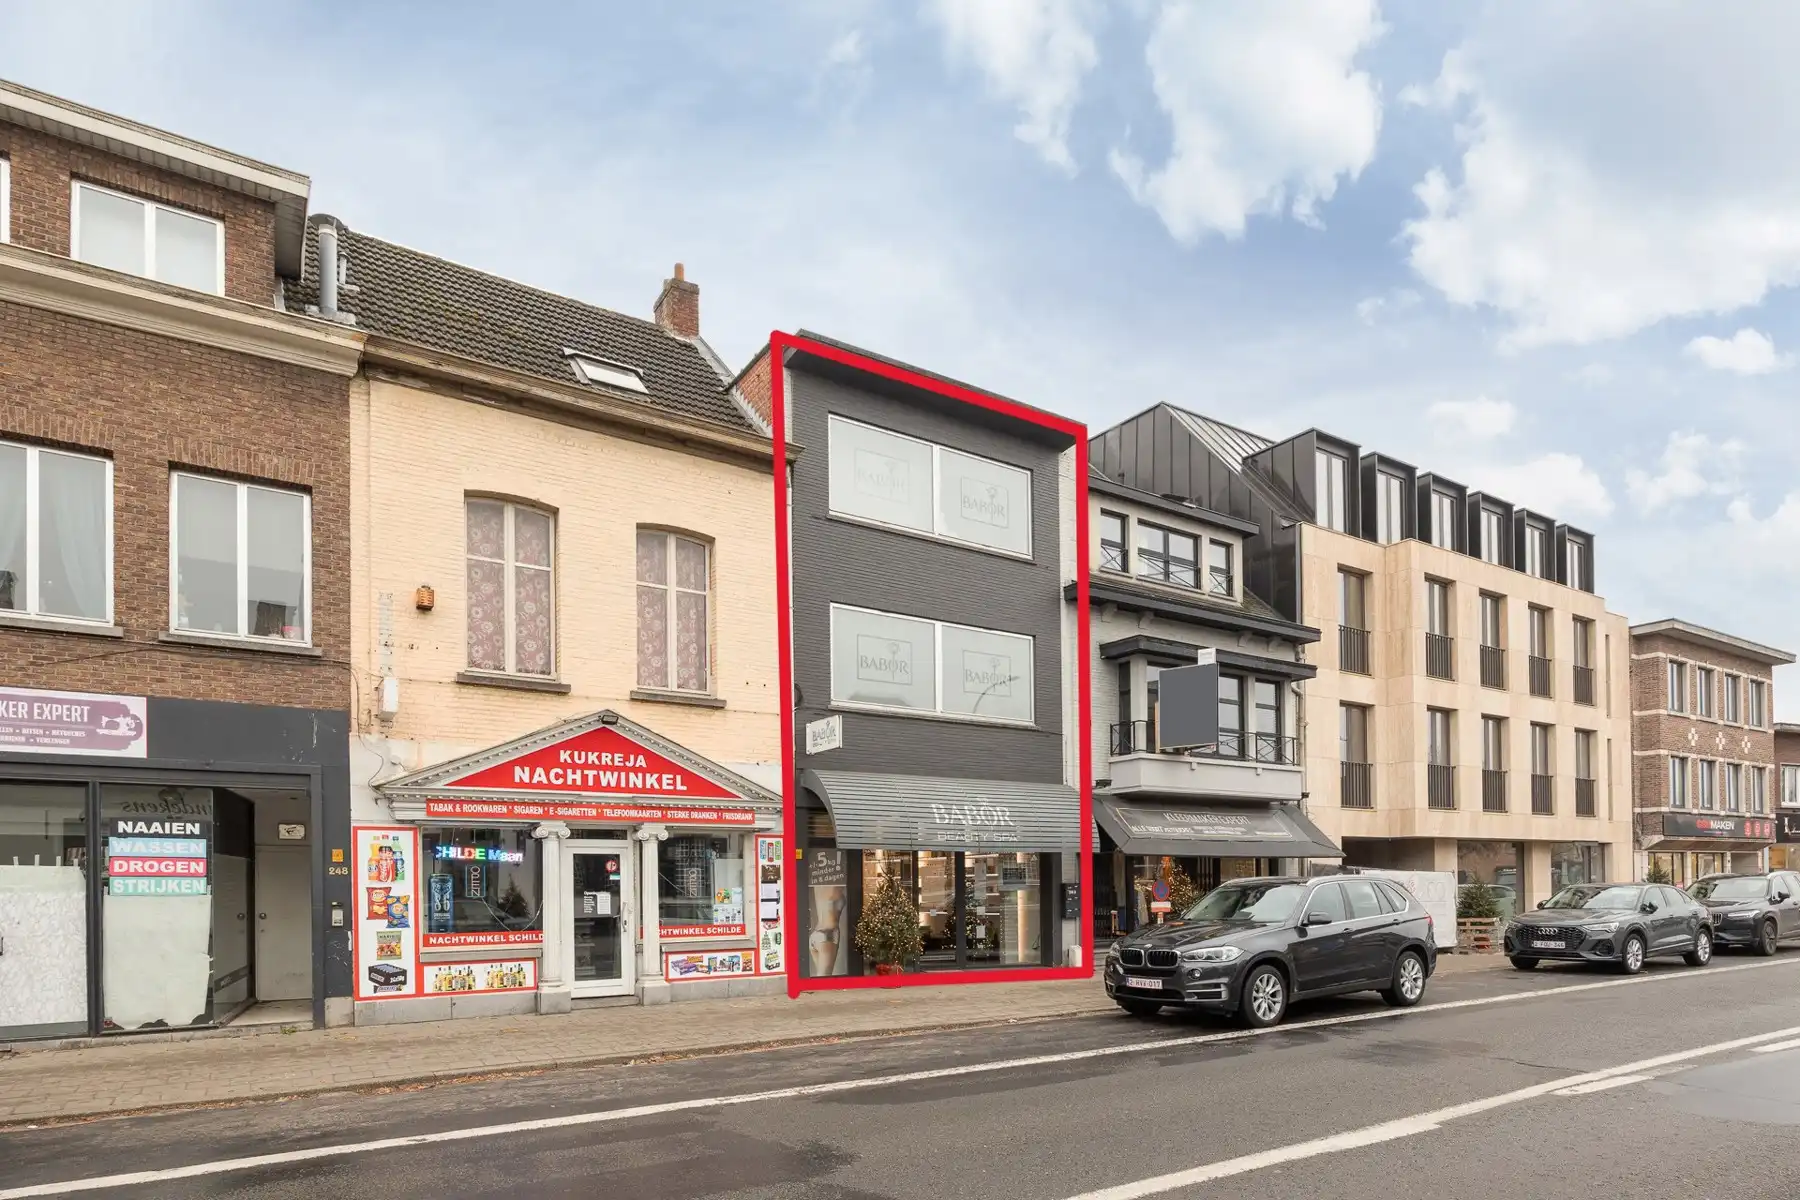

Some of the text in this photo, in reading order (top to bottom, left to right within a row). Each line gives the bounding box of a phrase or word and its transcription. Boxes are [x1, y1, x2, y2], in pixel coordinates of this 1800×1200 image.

[963, 495, 1006, 518] BABOR
[860, 655, 910, 675] BABOR
[965, 668, 1008, 687] BABOR
[34, 702, 91, 722] EXPERT
[560, 750, 647, 767] KUKREJA
[514, 766, 687, 790] NACHTWINKEL
[429, 803, 454, 812] TABAK
[455, 803, 461, 812] &
[463, 804, 507, 813] ROOKWAREN
[513, 805, 543, 815] SIGAREN
[603, 808, 661, 819] TELEFOONKAARTEN
[667, 810, 690, 819] STERKE
[691, 811, 717, 820] DRANKEN
[722, 812, 753, 821] FRISDRANK
[931, 804, 1014, 826] BABOR
[118, 821, 200, 834] NAAIEN
[993, 833, 1019, 842] SPA
[112, 841, 205, 853] WASSEN
[114, 860, 204, 873] DROGEN
[329, 867, 348, 875] 248
[812, 867, 834, 876] minder
[113, 880, 205, 893] STRIJKEN
[429, 934, 506, 944] NACHTWINKEL
